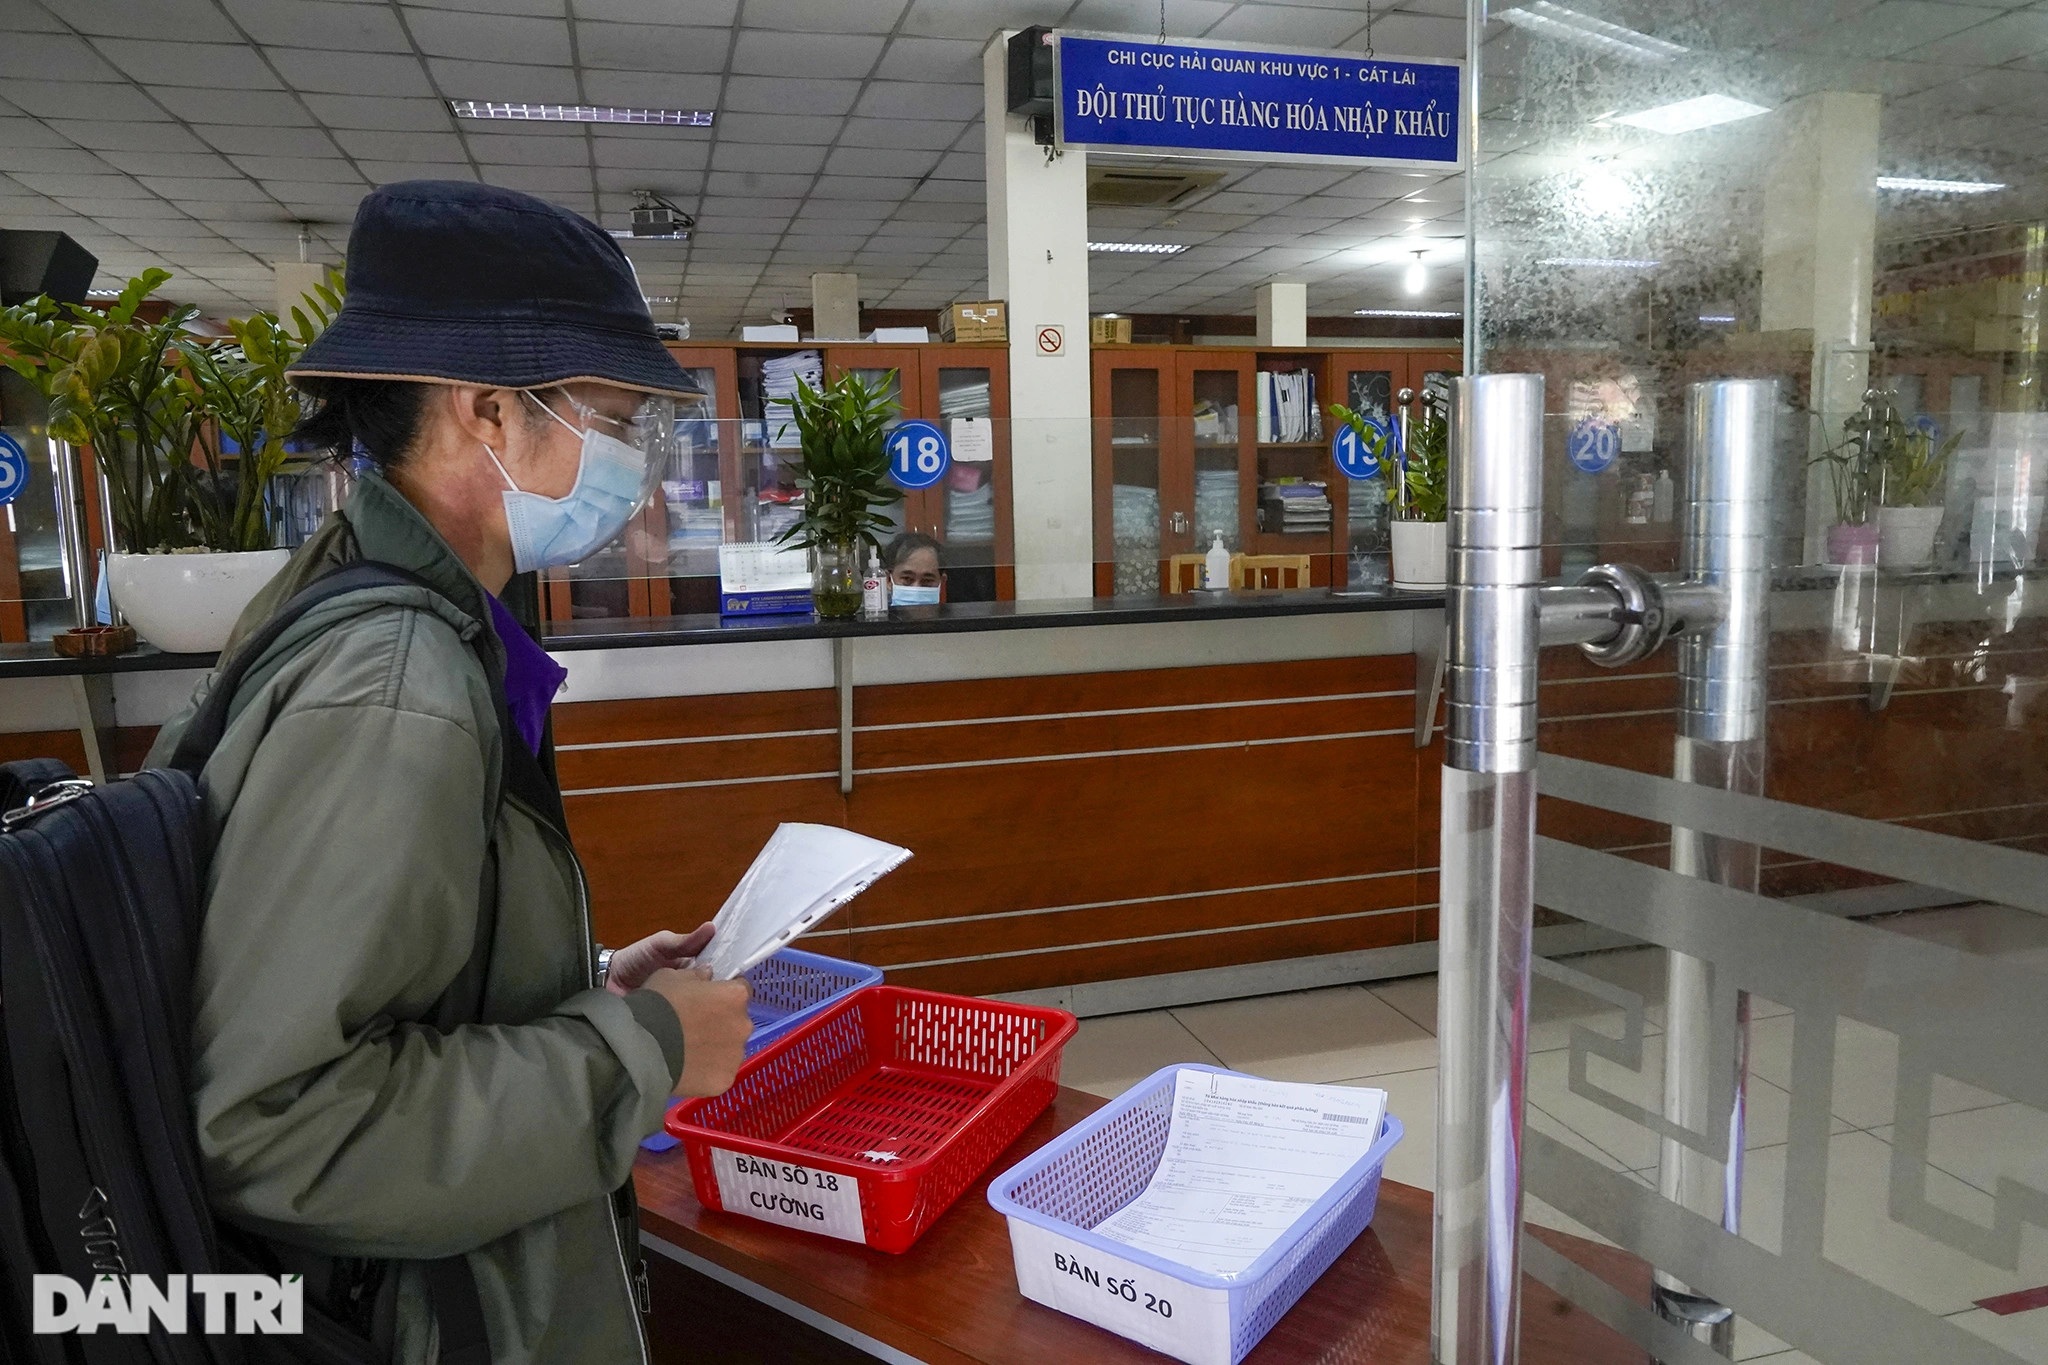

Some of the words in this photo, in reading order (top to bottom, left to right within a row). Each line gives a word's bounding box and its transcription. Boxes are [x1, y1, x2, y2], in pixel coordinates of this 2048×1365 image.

[1108, 50, 1136, 65] CHI
[1141, 52, 1175, 70] CỤC
[1180, 51, 1206, 70] HẢI
[1211, 57, 1255, 74] QUAN
[1261, 61, 1292, 77] KHU
[1297, 63, 1328, 80] VỰC
[1333, 67, 1340, 80] 1
[1358, 66, 1388, 83] CÁT
[1393, 68, 1416, 85] LÁI
[1077, 82, 1117, 125] ĐỘI
[1122, 84, 1167, 122] THỦ
[1172, 95, 1215, 130] TỤC
[1220, 91, 1280, 129] HÀNG
[1286, 97, 1329, 131] HÓA
[1334, 100, 1389, 139] NHẬP
[1394, 99, 1450, 138] KHẨU
[893, 436, 940, 473] 18
[1576, 427, 1614, 460] 20
[735, 1155, 777, 1180] BÀN
[814, 1172, 839, 1192] 18
[750, 1190, 825, 1221] CƯỜNG
[1054, 1252, 1100, 1288] BÀN
[1106, 1278, 1137, 1302] SỐ
[1144, 1292, 1173, 1318] 20
